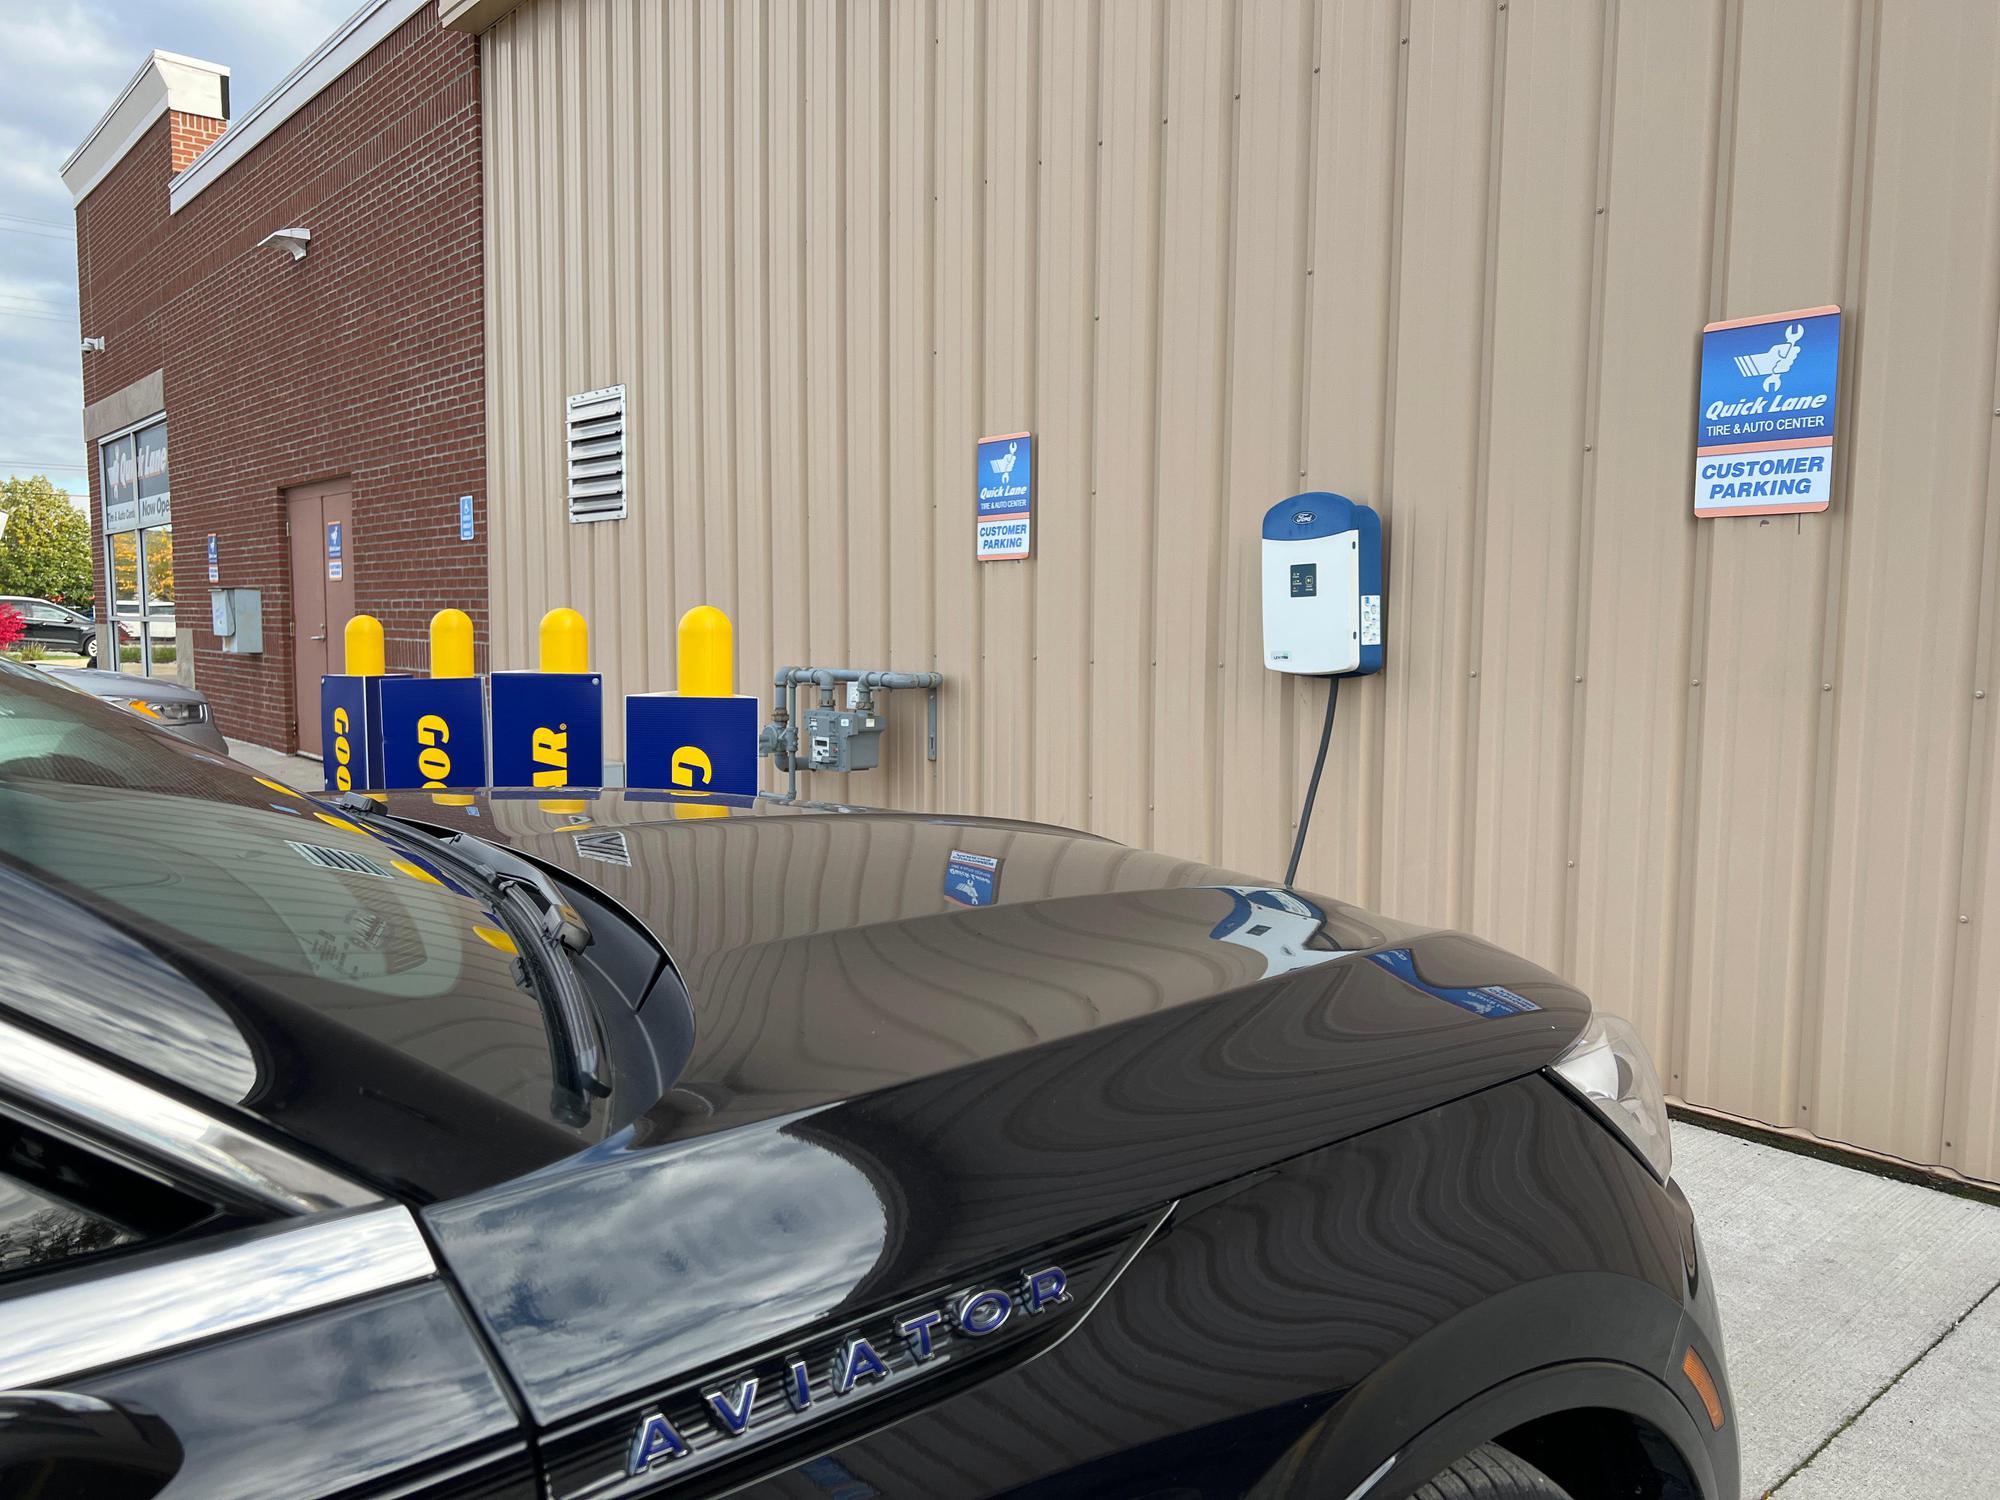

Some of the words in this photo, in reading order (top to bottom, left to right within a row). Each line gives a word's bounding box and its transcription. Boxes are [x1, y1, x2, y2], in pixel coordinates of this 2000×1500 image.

[1706, 396, 1768, 420] Quick
[1768, 393, 1827, 413] Lane
[1706, 424, 1731, 437] TIRE
[1733, 422, 1742, 434] &
[1742, 419, 1774, 433] AUTO
[1776, 416, 1825, 430] CENTER
[1701, 456, 1825, 480] CUSTOMER
[980, 486, 1004, 500] Quick
[1004, 484, 1028, 497] Lane
[1709, 478, 1812, 500] PARKING
[142, 501, 156, 517] Now
[979, 524, 1027, 537] CUSTOMER
[983, 537, 1022, 550] PARKING
[417, 714, 451, 789] GO
[629, 1265, 1073, 1477] AVIATOR
